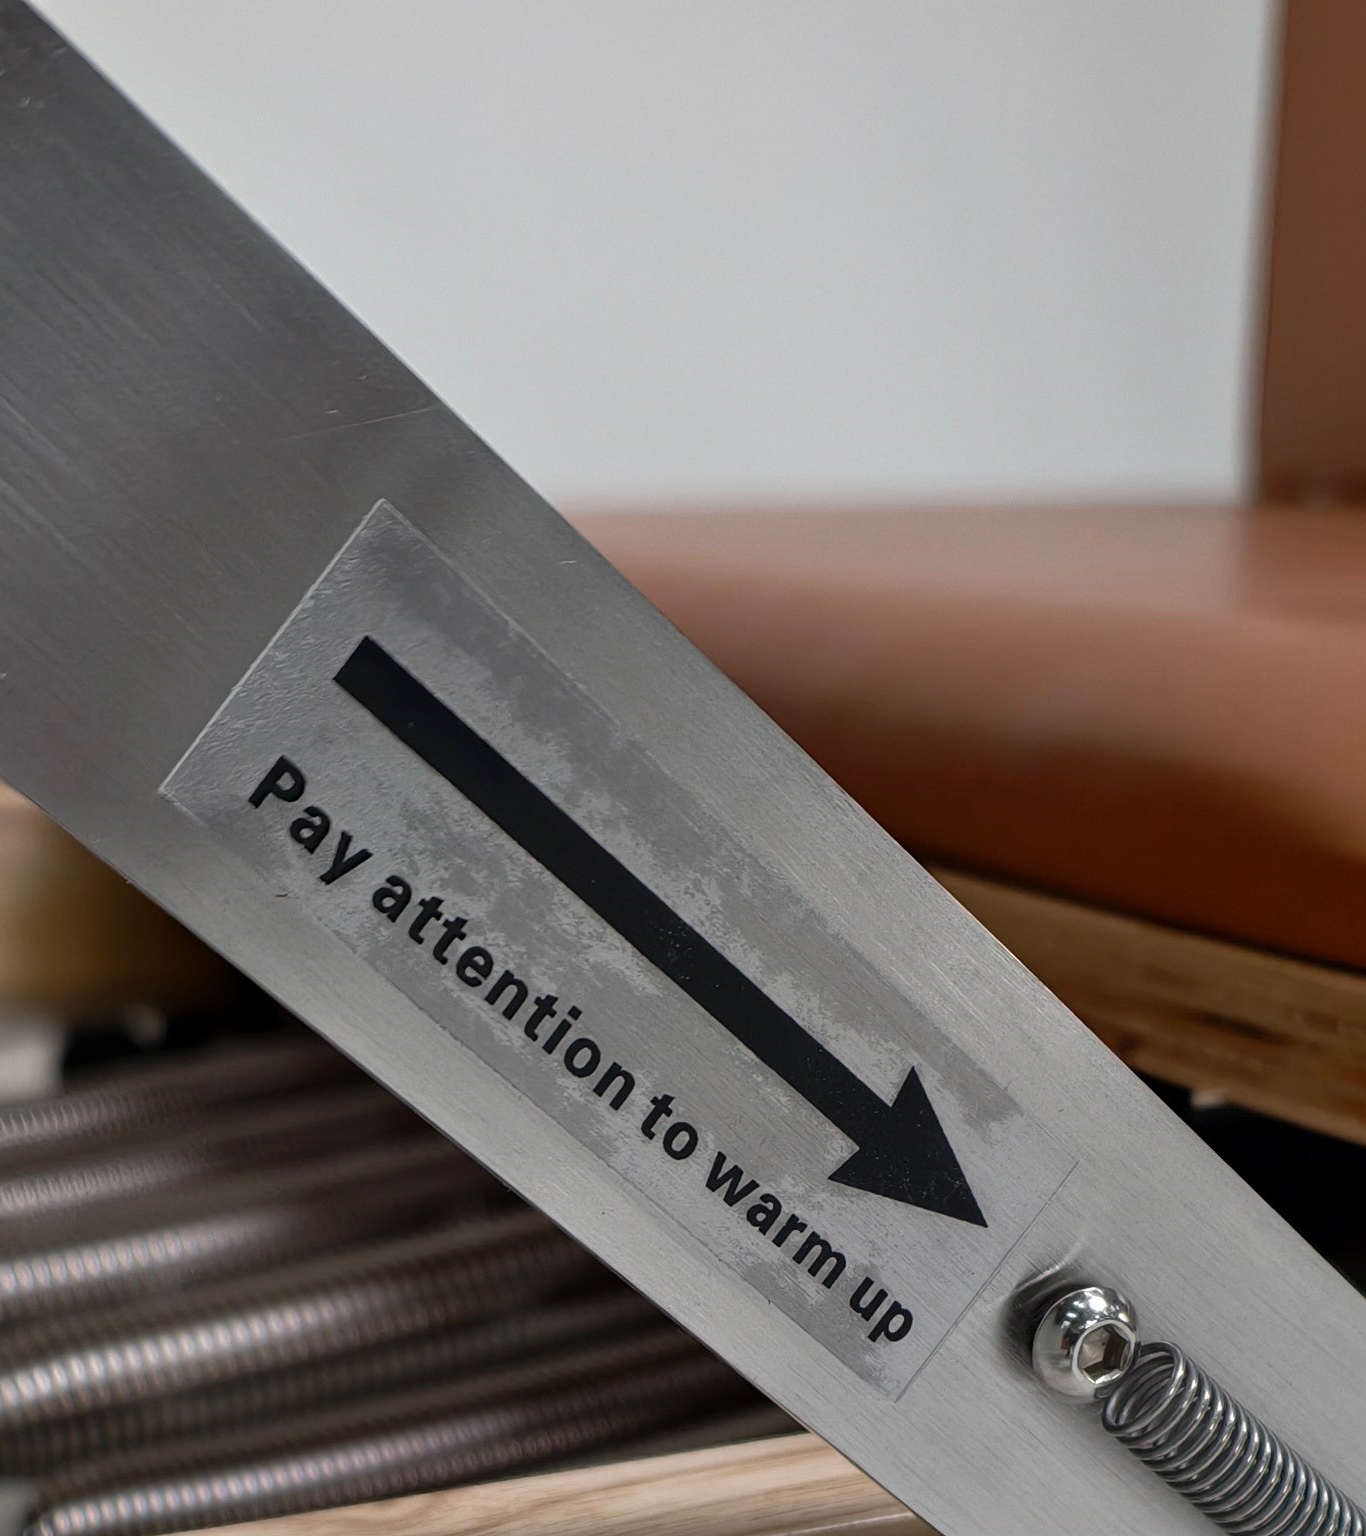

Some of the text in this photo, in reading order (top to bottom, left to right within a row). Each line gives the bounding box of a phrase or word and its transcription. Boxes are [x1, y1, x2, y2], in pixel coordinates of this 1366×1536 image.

[247, 754, 914, 1343] Pay attention to warm up
